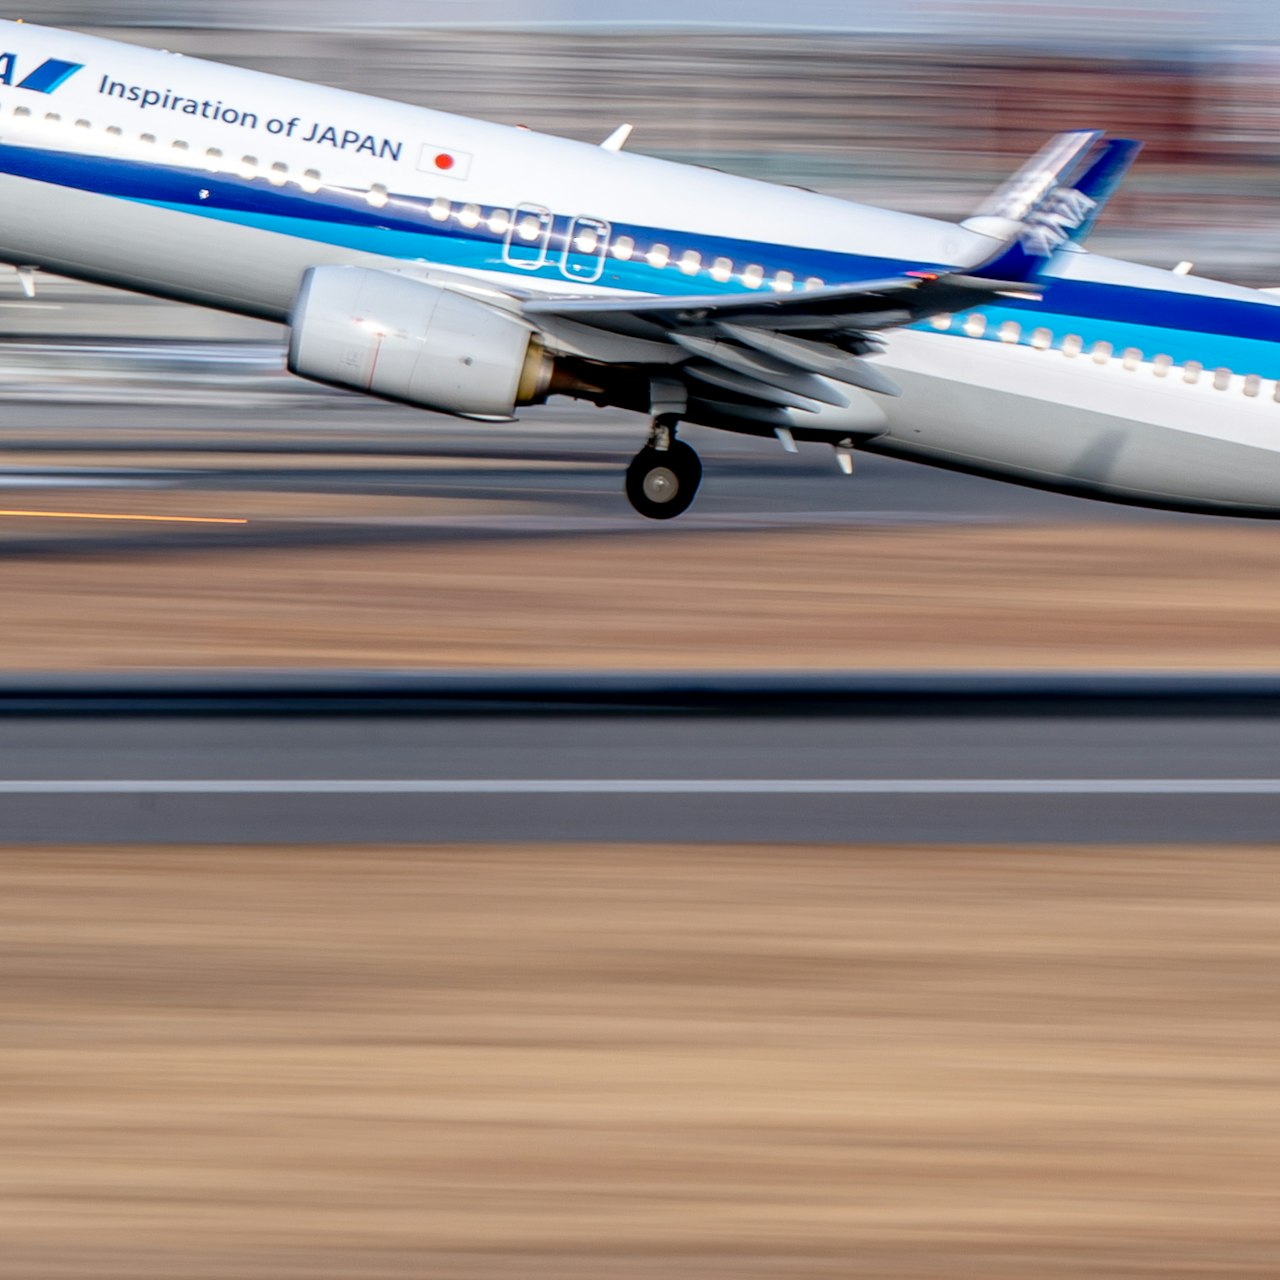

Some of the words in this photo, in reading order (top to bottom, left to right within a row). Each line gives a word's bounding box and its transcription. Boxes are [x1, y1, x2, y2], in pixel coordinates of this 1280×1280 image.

[98, 75, 258, 128] Inspiration
[266, 115, 300, 137] of
[302, 122, 403, 161] JAPAN
